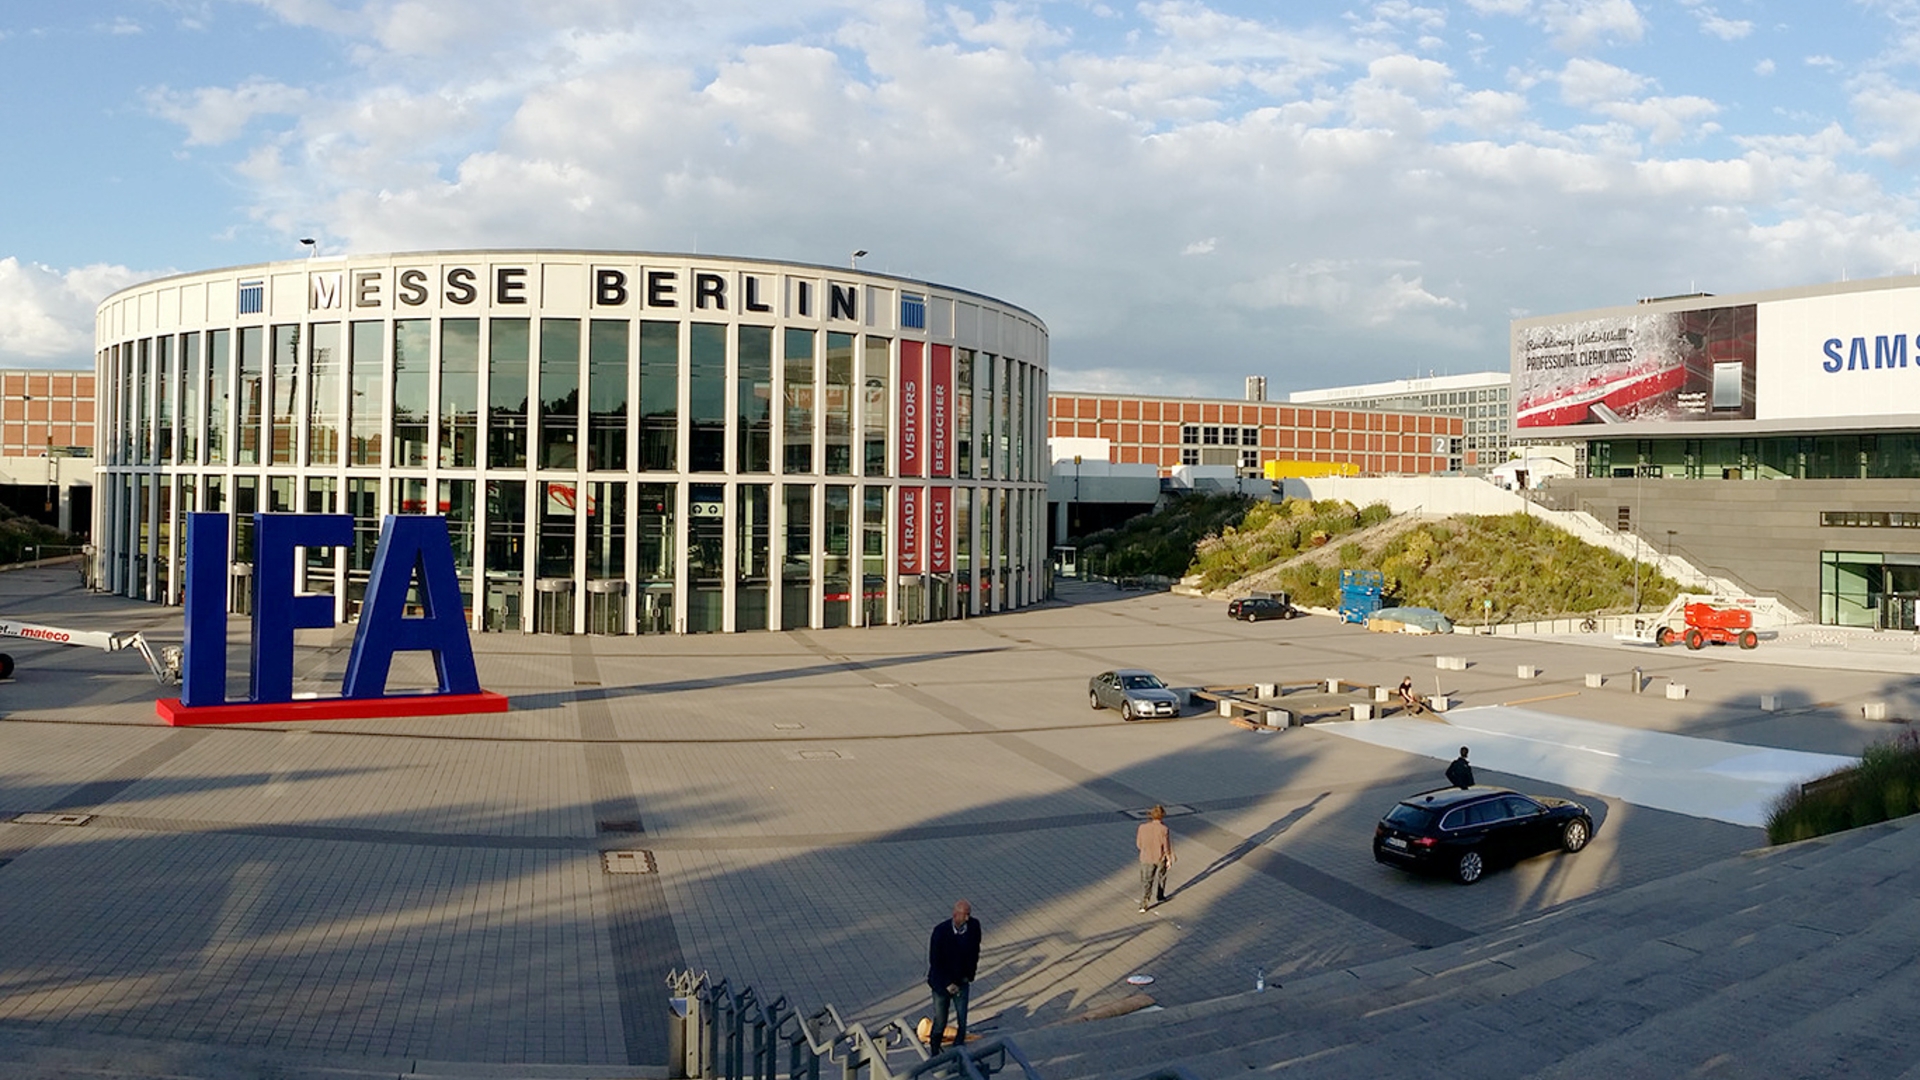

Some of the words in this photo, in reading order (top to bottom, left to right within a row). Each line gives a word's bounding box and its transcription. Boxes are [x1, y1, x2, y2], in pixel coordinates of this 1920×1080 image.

[311, 268, 527, 311] MESSE
[597, 269, 858, 320] BERLIN
[1526, 353, 1578, 371] PROFESSIONAL
[1823, 334, 1920, 373] SAM
[905, 381, 916, 461] VISITORS
[935, 384, 945, 471] BESUCHER
[1436, 438, 1445, 453] 2
[904, 492, 914, 549] TRADE
[935, 502, 944, 549] FACH
[180, 511, 481, 707] IFA
[21, 628, 70, 642] mateco
